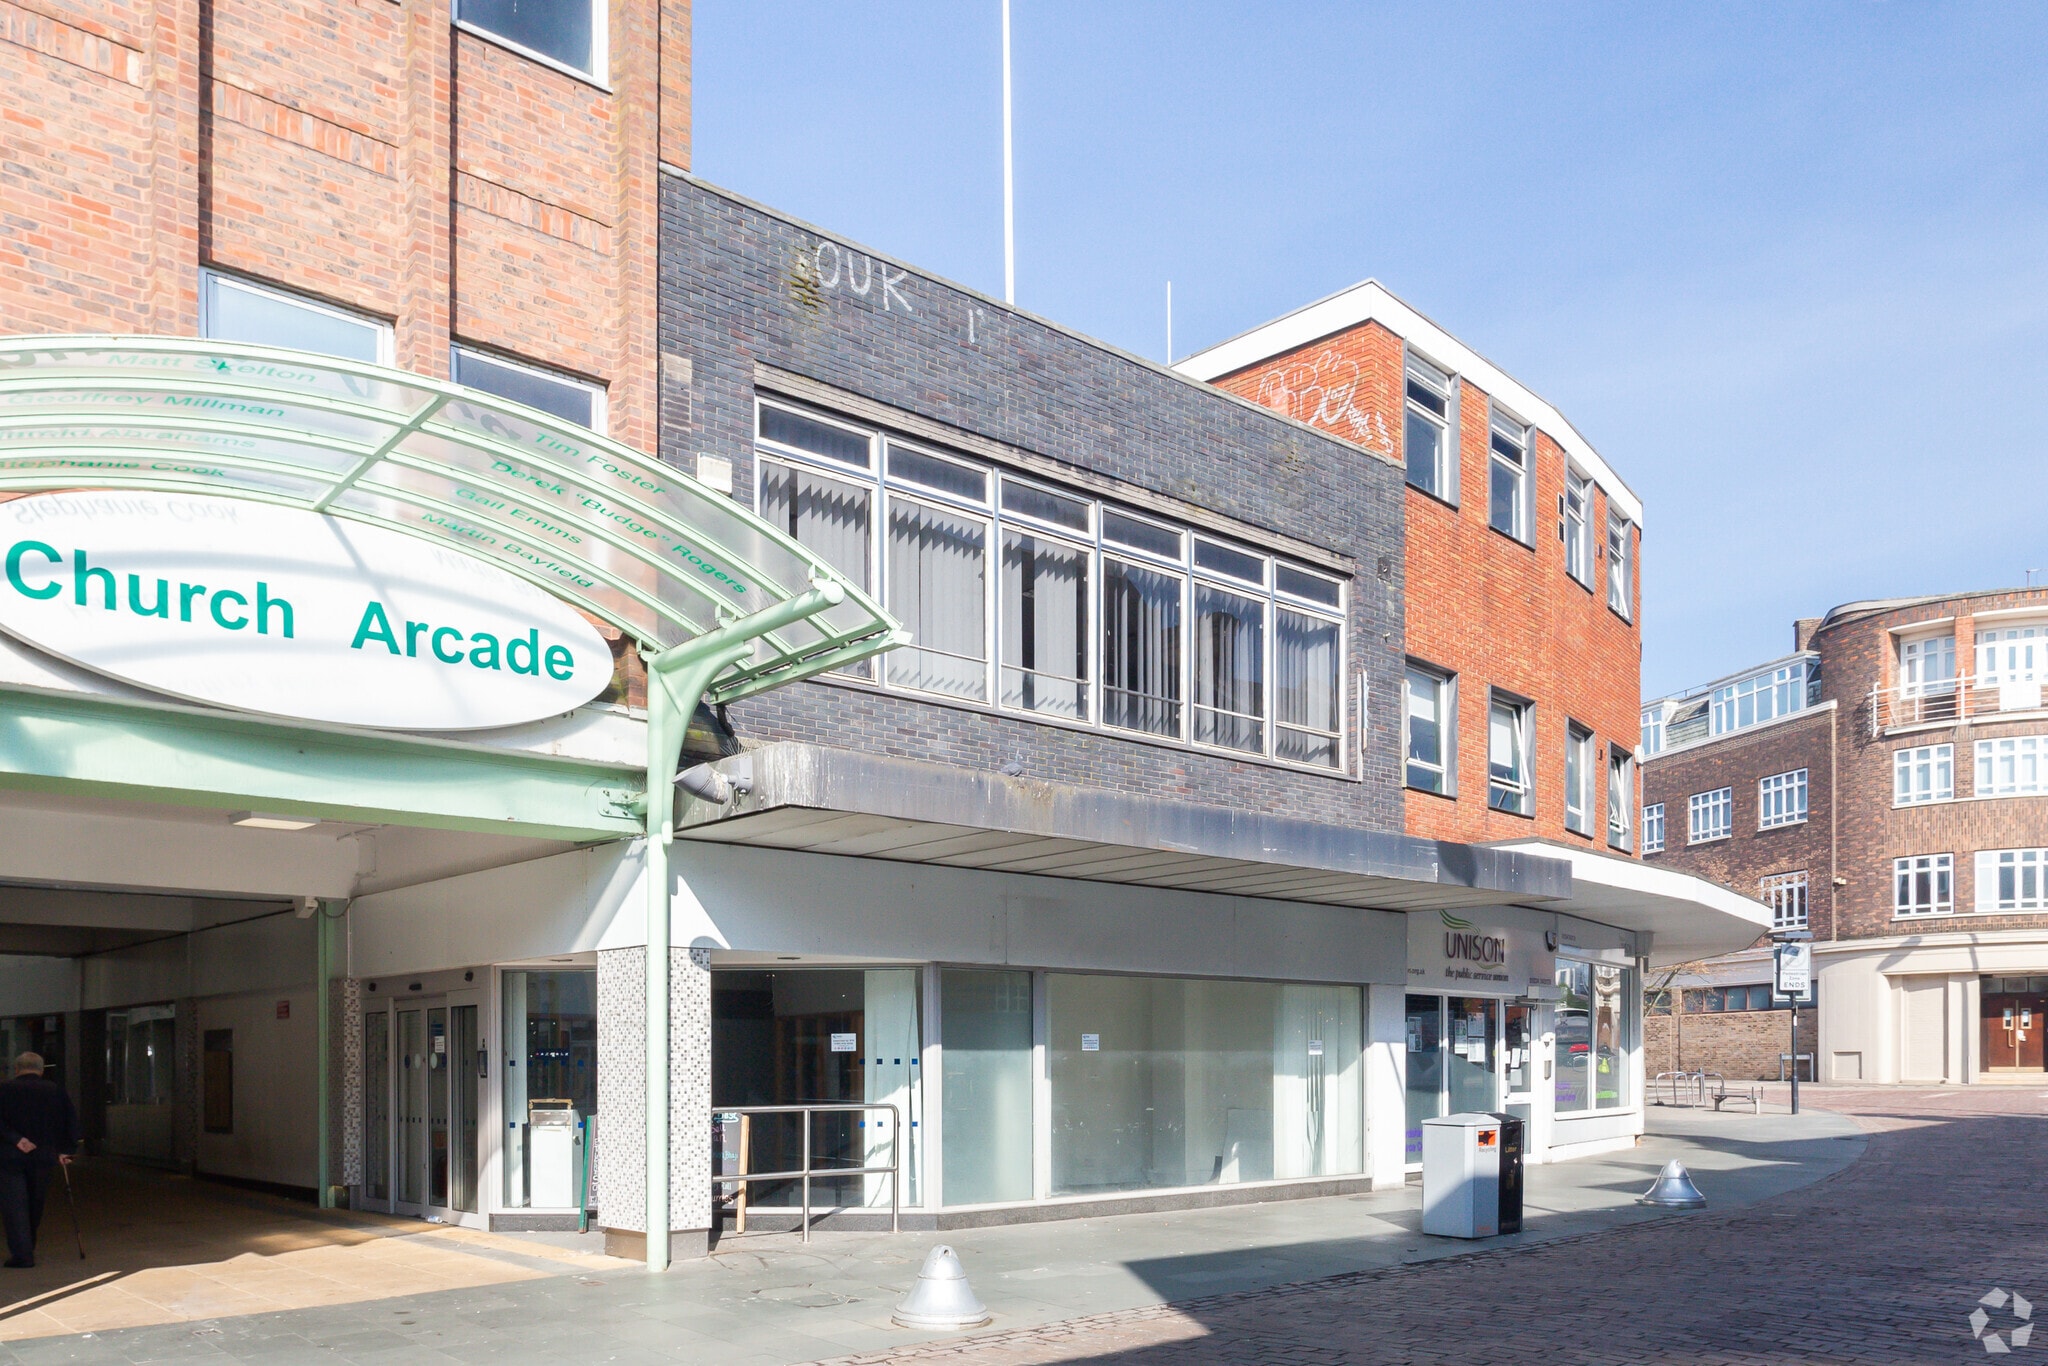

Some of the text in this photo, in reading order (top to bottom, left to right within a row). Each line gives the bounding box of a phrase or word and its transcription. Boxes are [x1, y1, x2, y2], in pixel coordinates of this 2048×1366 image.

[107, 353, 182, 367] Matt
[193, 356, 317, 384] Skelton
[8, 392, 286, 417] Geoffrey Millman
[99, 428, 257, 449] Abrahams
[151, 462, 226, 478] Cook
[532, 430, 666, 496] Tim Foster
[455, 487, 583, 545] Gail Emms
[490, 460, 566, 497] Derek
[671, 544, 748, 594] Rogers
[421, 512, 497, 546] Martin
[503, 542, 595, 589] Bayfield
[4, 539, 576, 681] Church Arcade
[1446, 931, 1505, 963] UNISON
[1445, 966, 1455, 977] the
[1455, 967, 1473, 980] public
